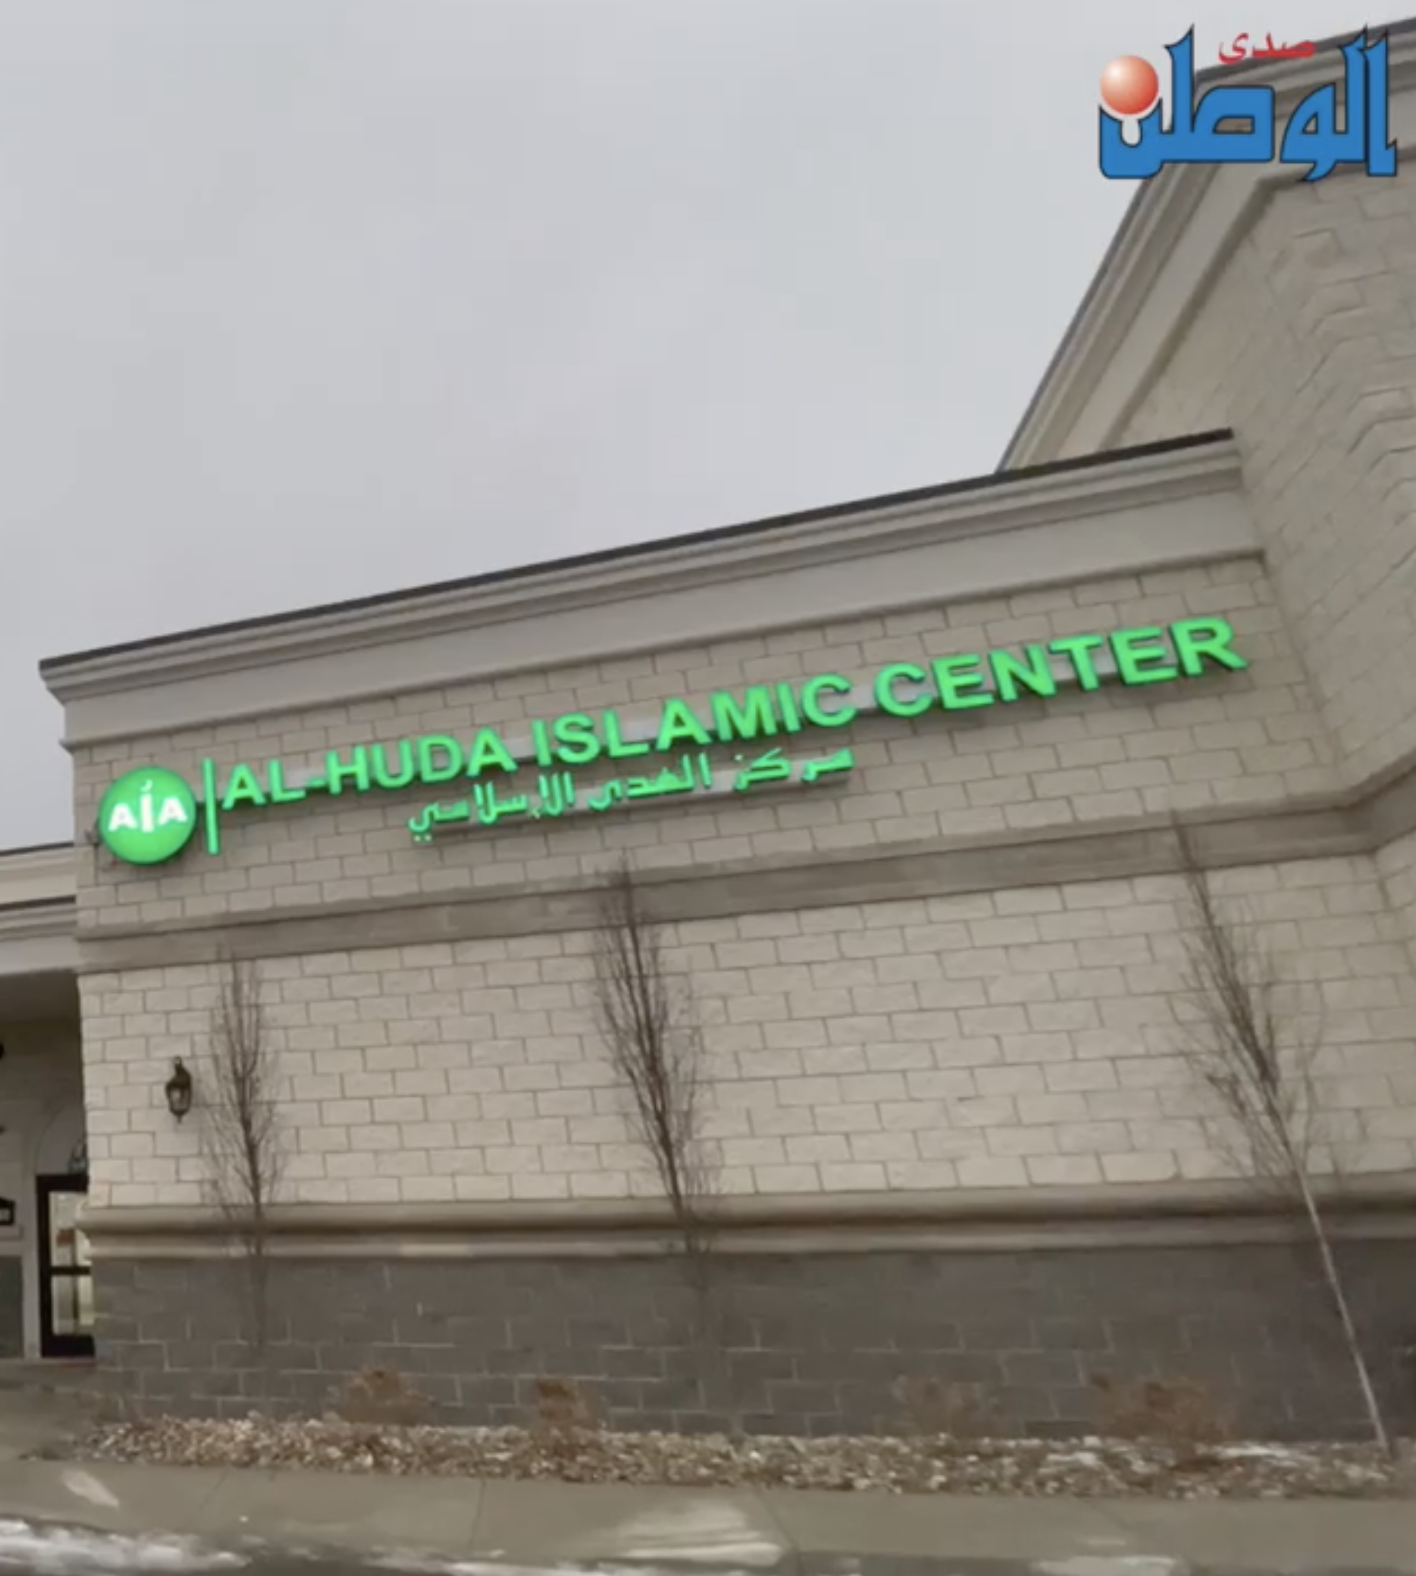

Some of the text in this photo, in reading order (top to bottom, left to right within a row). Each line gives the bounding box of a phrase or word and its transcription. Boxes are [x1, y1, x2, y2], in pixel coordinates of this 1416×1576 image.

[221, 615, 1249, 811] AL-HUDA ISLAMIC CENTER
[587, 751, 712, 811] الهدى
[733, 746, 855, 793] مركز
